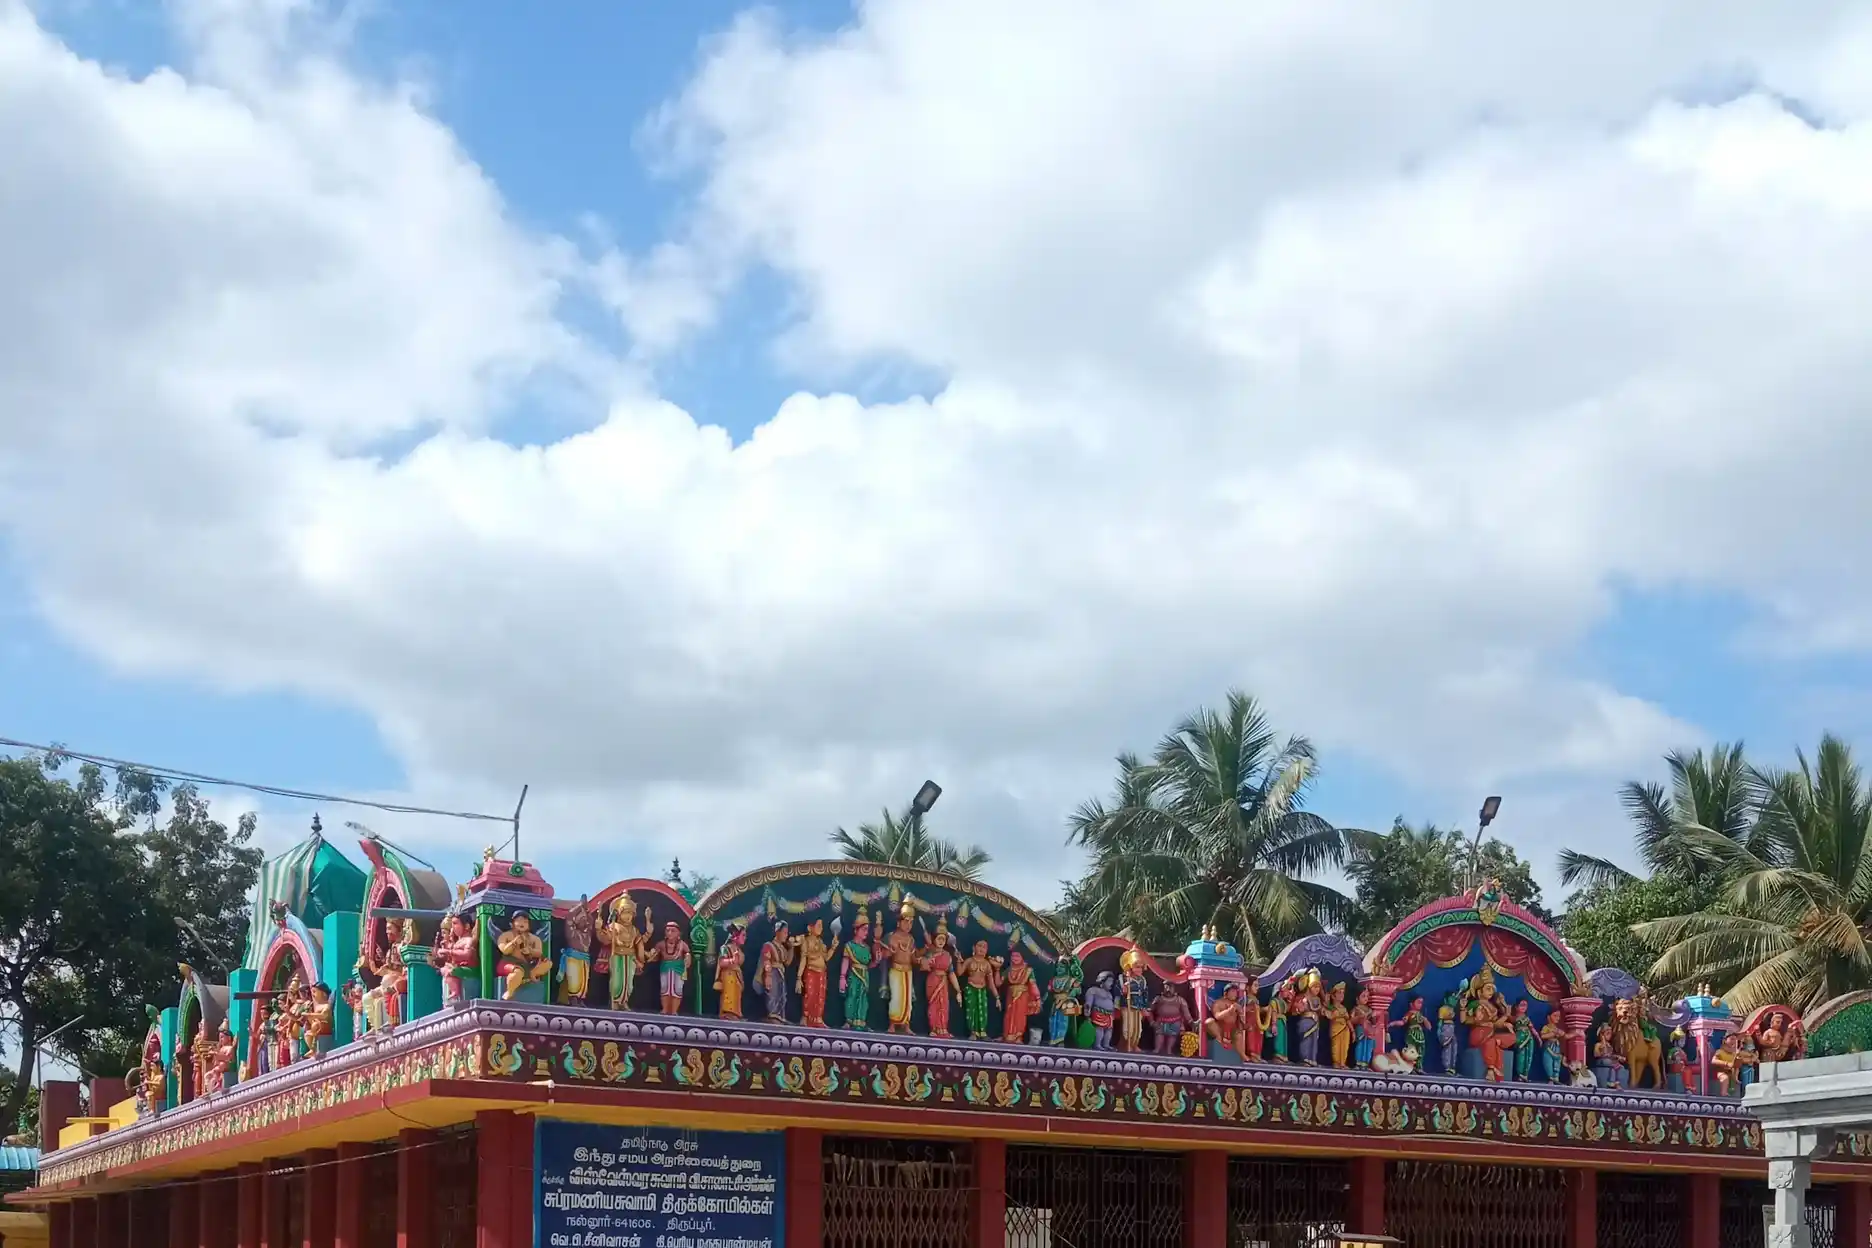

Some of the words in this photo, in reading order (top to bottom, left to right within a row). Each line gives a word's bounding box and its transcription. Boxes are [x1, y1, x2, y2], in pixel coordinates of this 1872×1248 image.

[673, 1137, 699, 1152] அரசு
[573, 1146, 616, 1167] இந்து
[618, 1154, 648, 1165] சமய
[660, 1192, 774, 1215] திருக்கோயில்கள்
